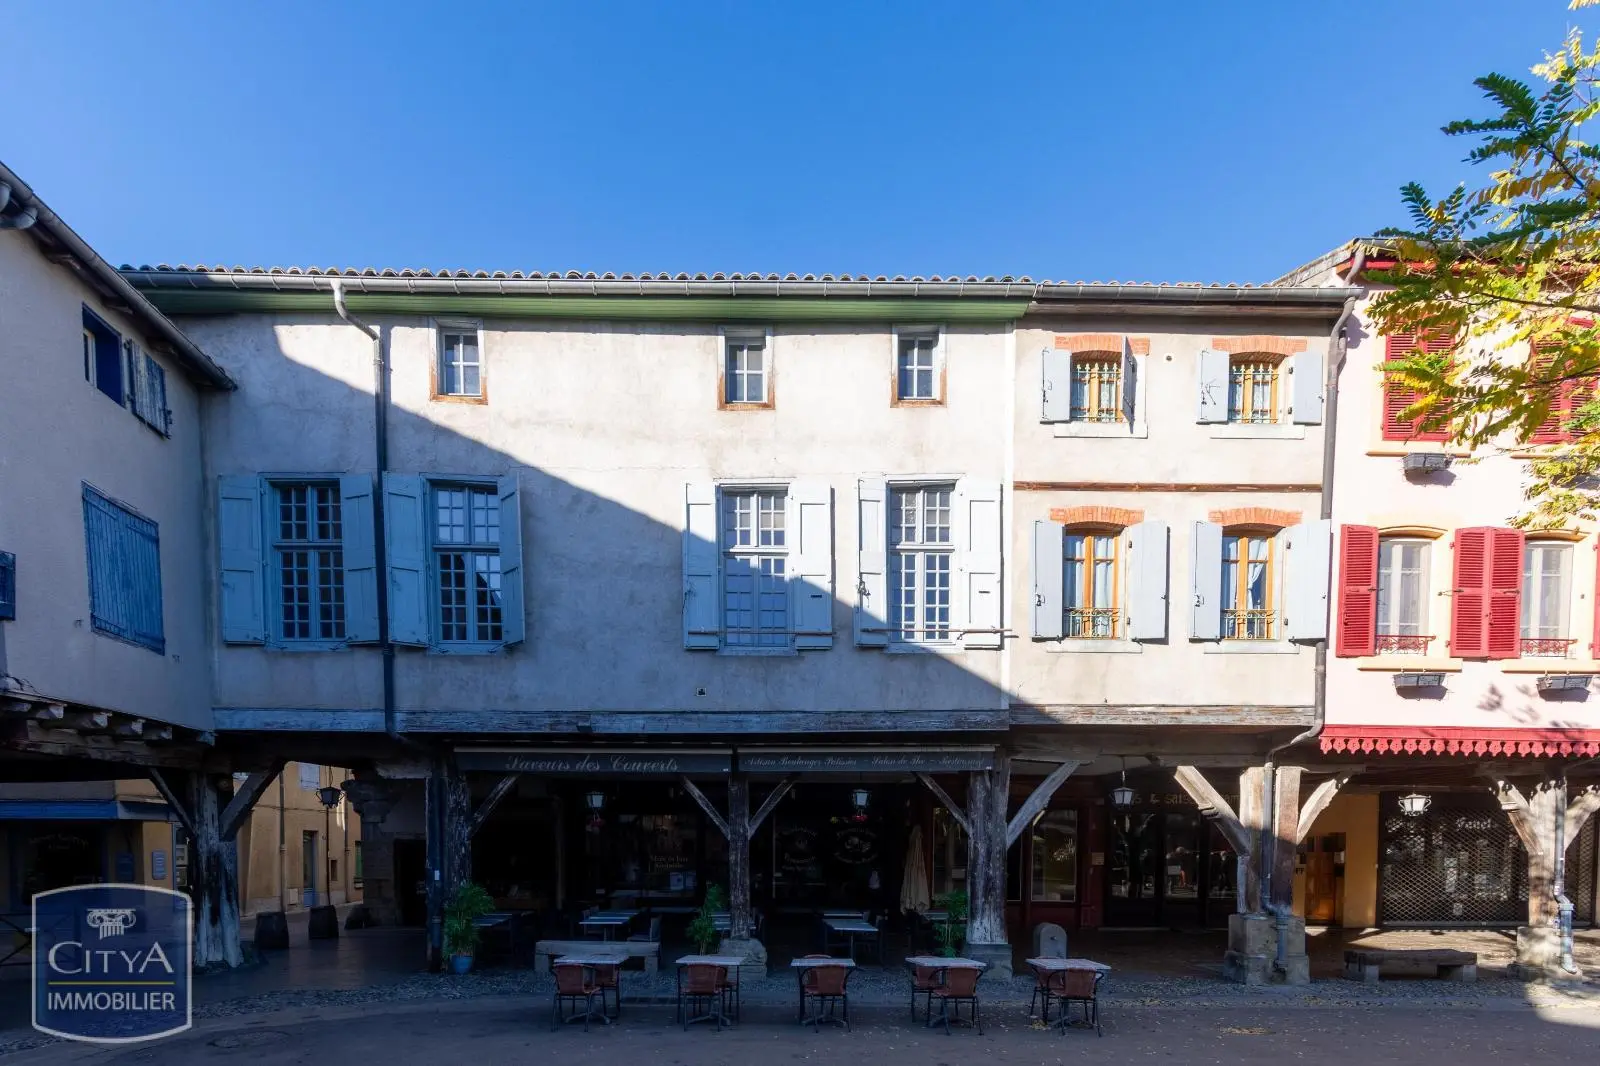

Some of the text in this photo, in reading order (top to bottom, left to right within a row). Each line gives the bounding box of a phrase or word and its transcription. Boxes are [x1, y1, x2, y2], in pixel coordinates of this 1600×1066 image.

[505, 754, 679, 772] Saveurs des Couverts
